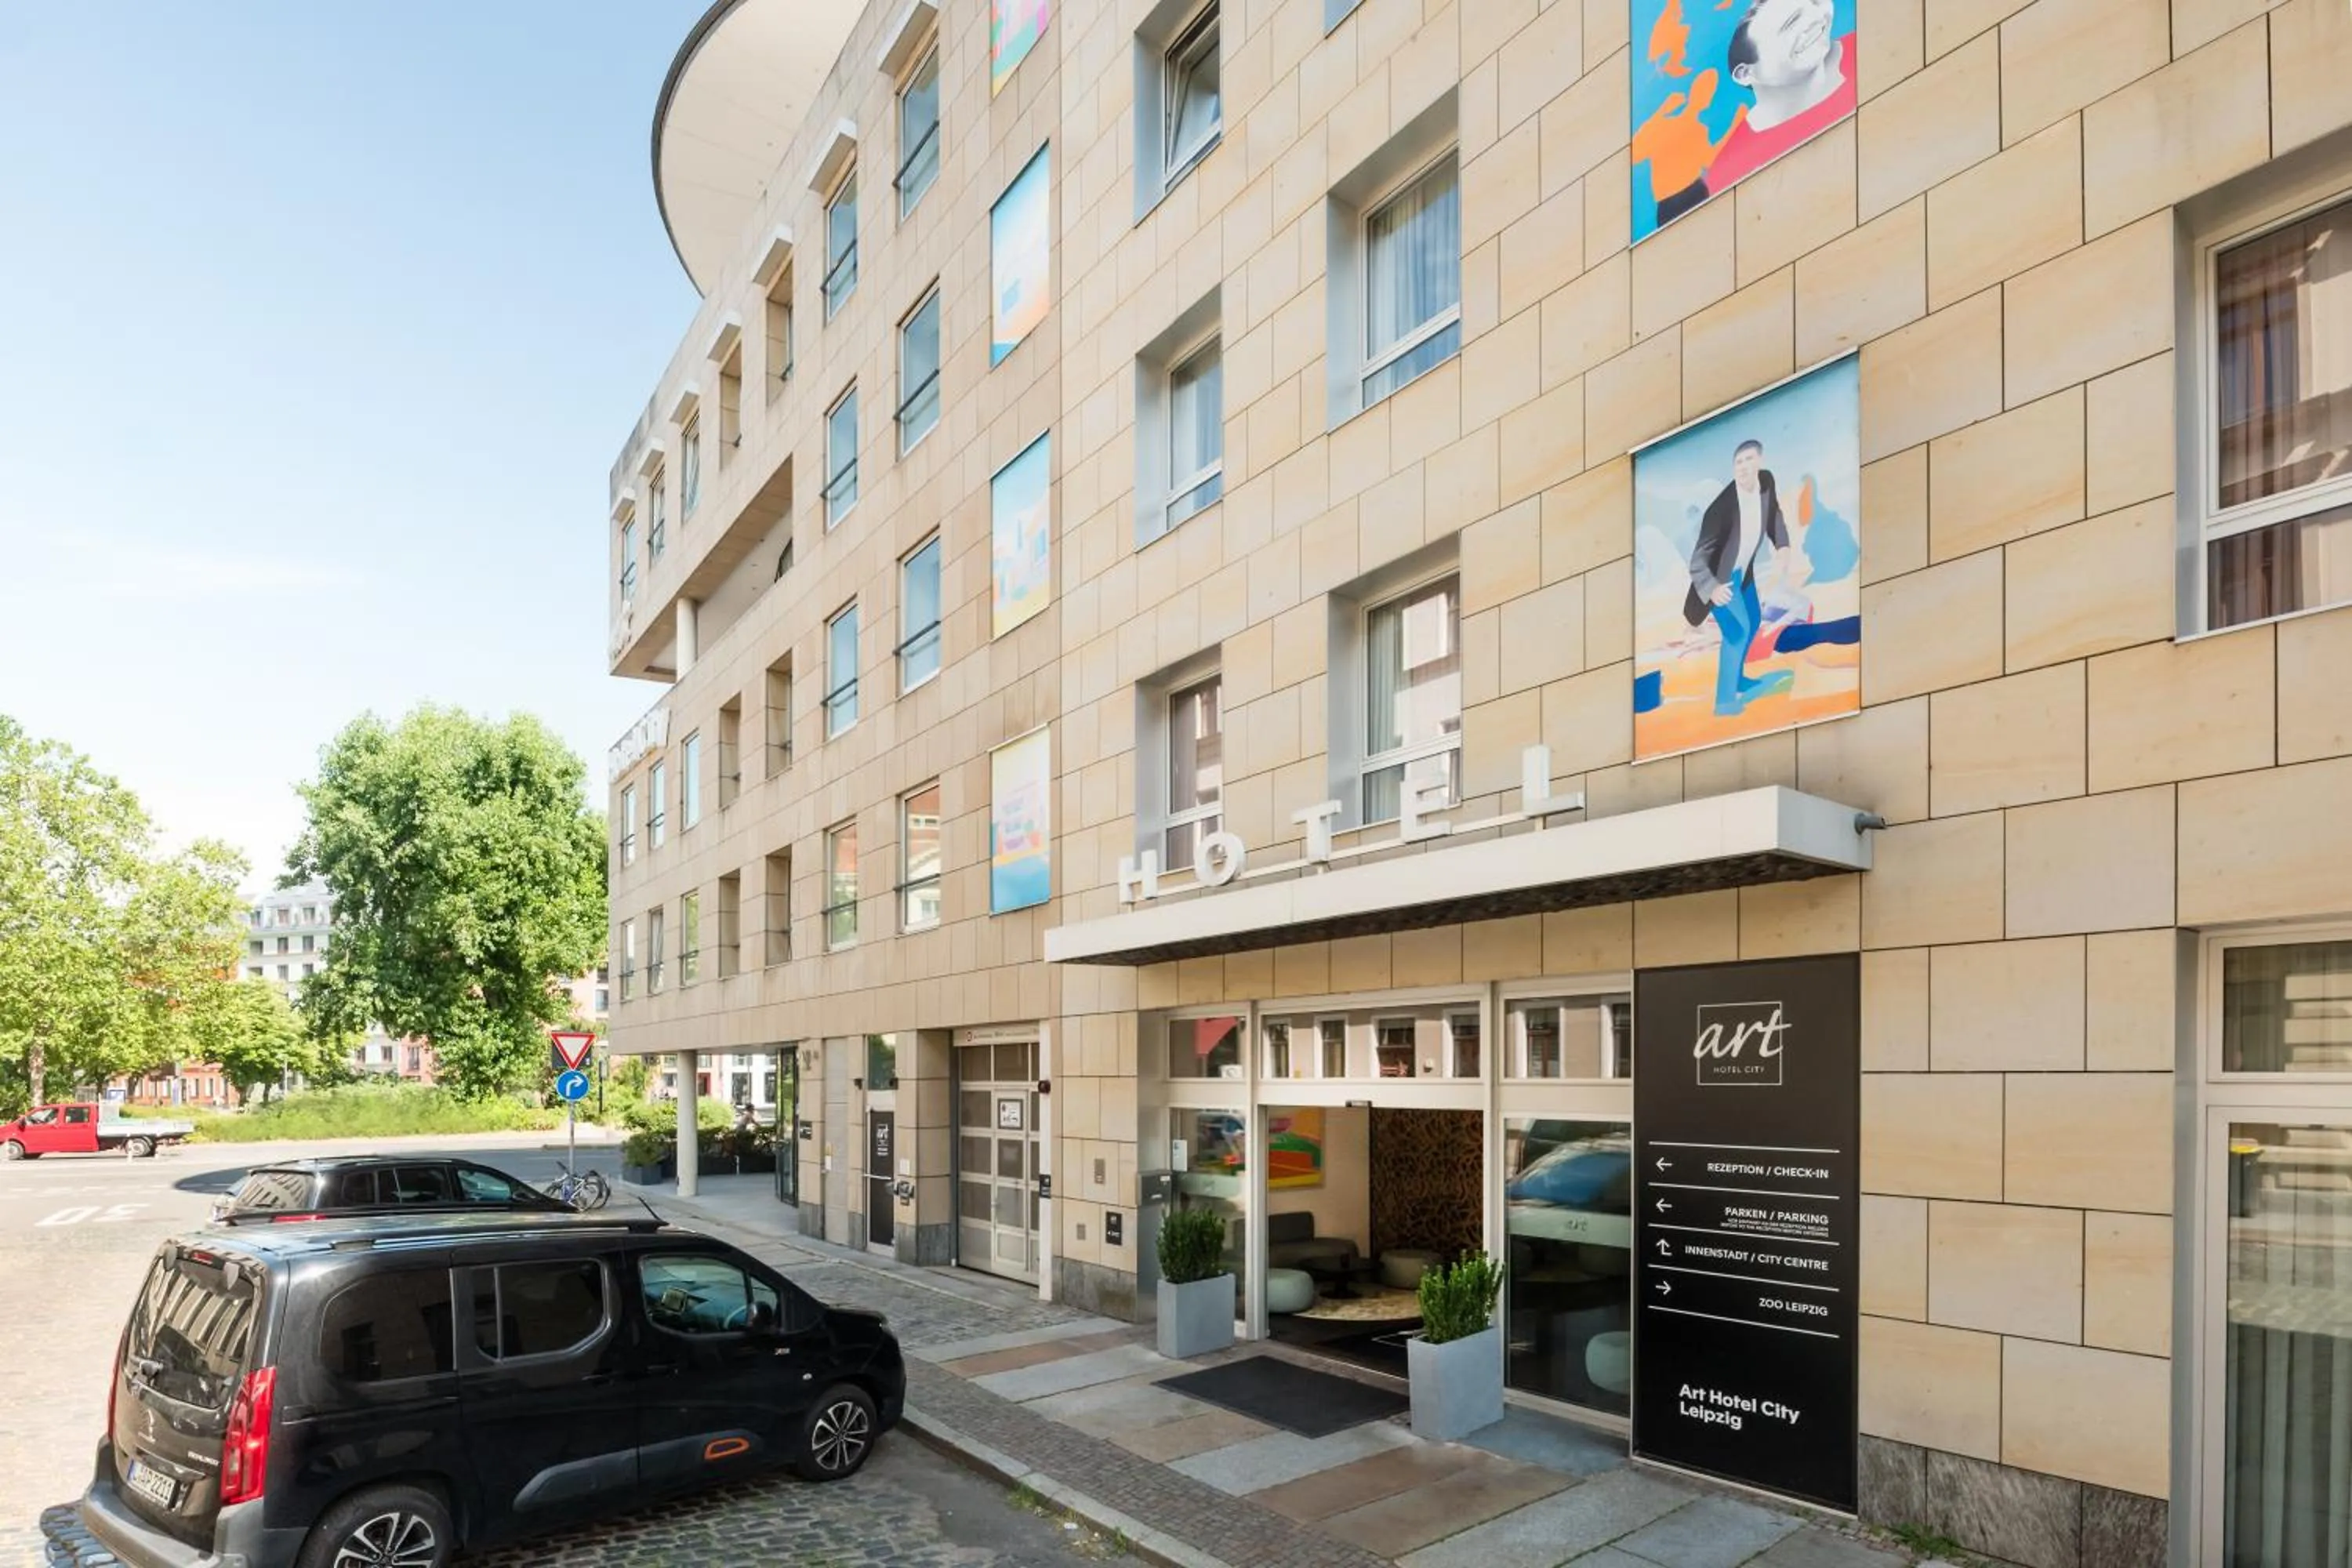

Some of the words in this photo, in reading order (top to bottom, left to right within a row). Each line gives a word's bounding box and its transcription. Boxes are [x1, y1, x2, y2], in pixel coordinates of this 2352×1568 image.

[1119, 744, 1584, 904] HOTEL
[1693, 1009, 1792, 1058] art
[1707, 1163, 1763, 1175] REZEPTION
[1766, 1167, 1771, 1175] /
[1773, 1167, 1829, 1178] CHECK-IN
[1725, 1207, 1766, 1219] PARKEN
[1769, 1211, 1775, 1221] /
[1777, 1211, 1829, 1225] PARKING
[1685, 1245, 1748, 1261] INNENSTADT
[1751, 1254, 1755, 1263] /
[1757, 1254, 1782, 1265] CITY
[1784, 1257, 1829, 1271] CENTRE
[1759, 1298, 1784, 1308] ZOO
[1785, 1301, 1828, 1316] LEIPZIG
[1679, 1383, 1707, 1402] Art
[1709, 1388, 1758, 1414] Hotel
[1760, 1400, 1801, 1425] City
[1679, 1401, 1742, 1431] Leipzig
